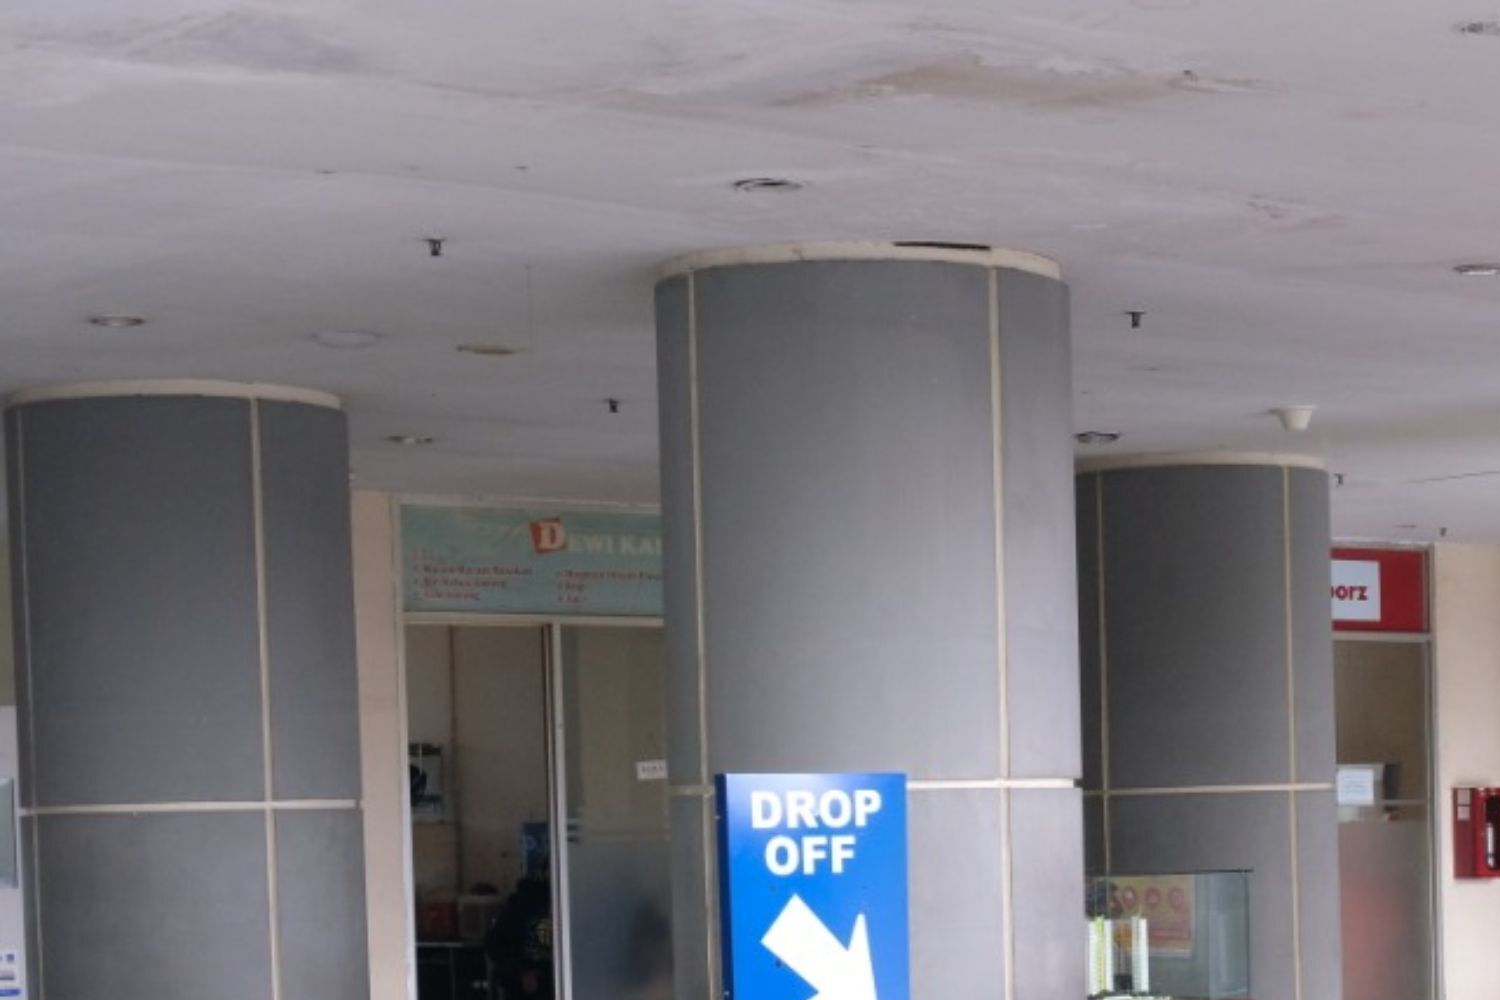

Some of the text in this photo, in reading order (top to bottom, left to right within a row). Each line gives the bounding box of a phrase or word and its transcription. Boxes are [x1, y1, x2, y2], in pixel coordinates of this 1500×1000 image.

[1331, 585, 1368, 601] orz
[751, 789, 883, 830] DROP
[765, 834, 857, 877] OFF
